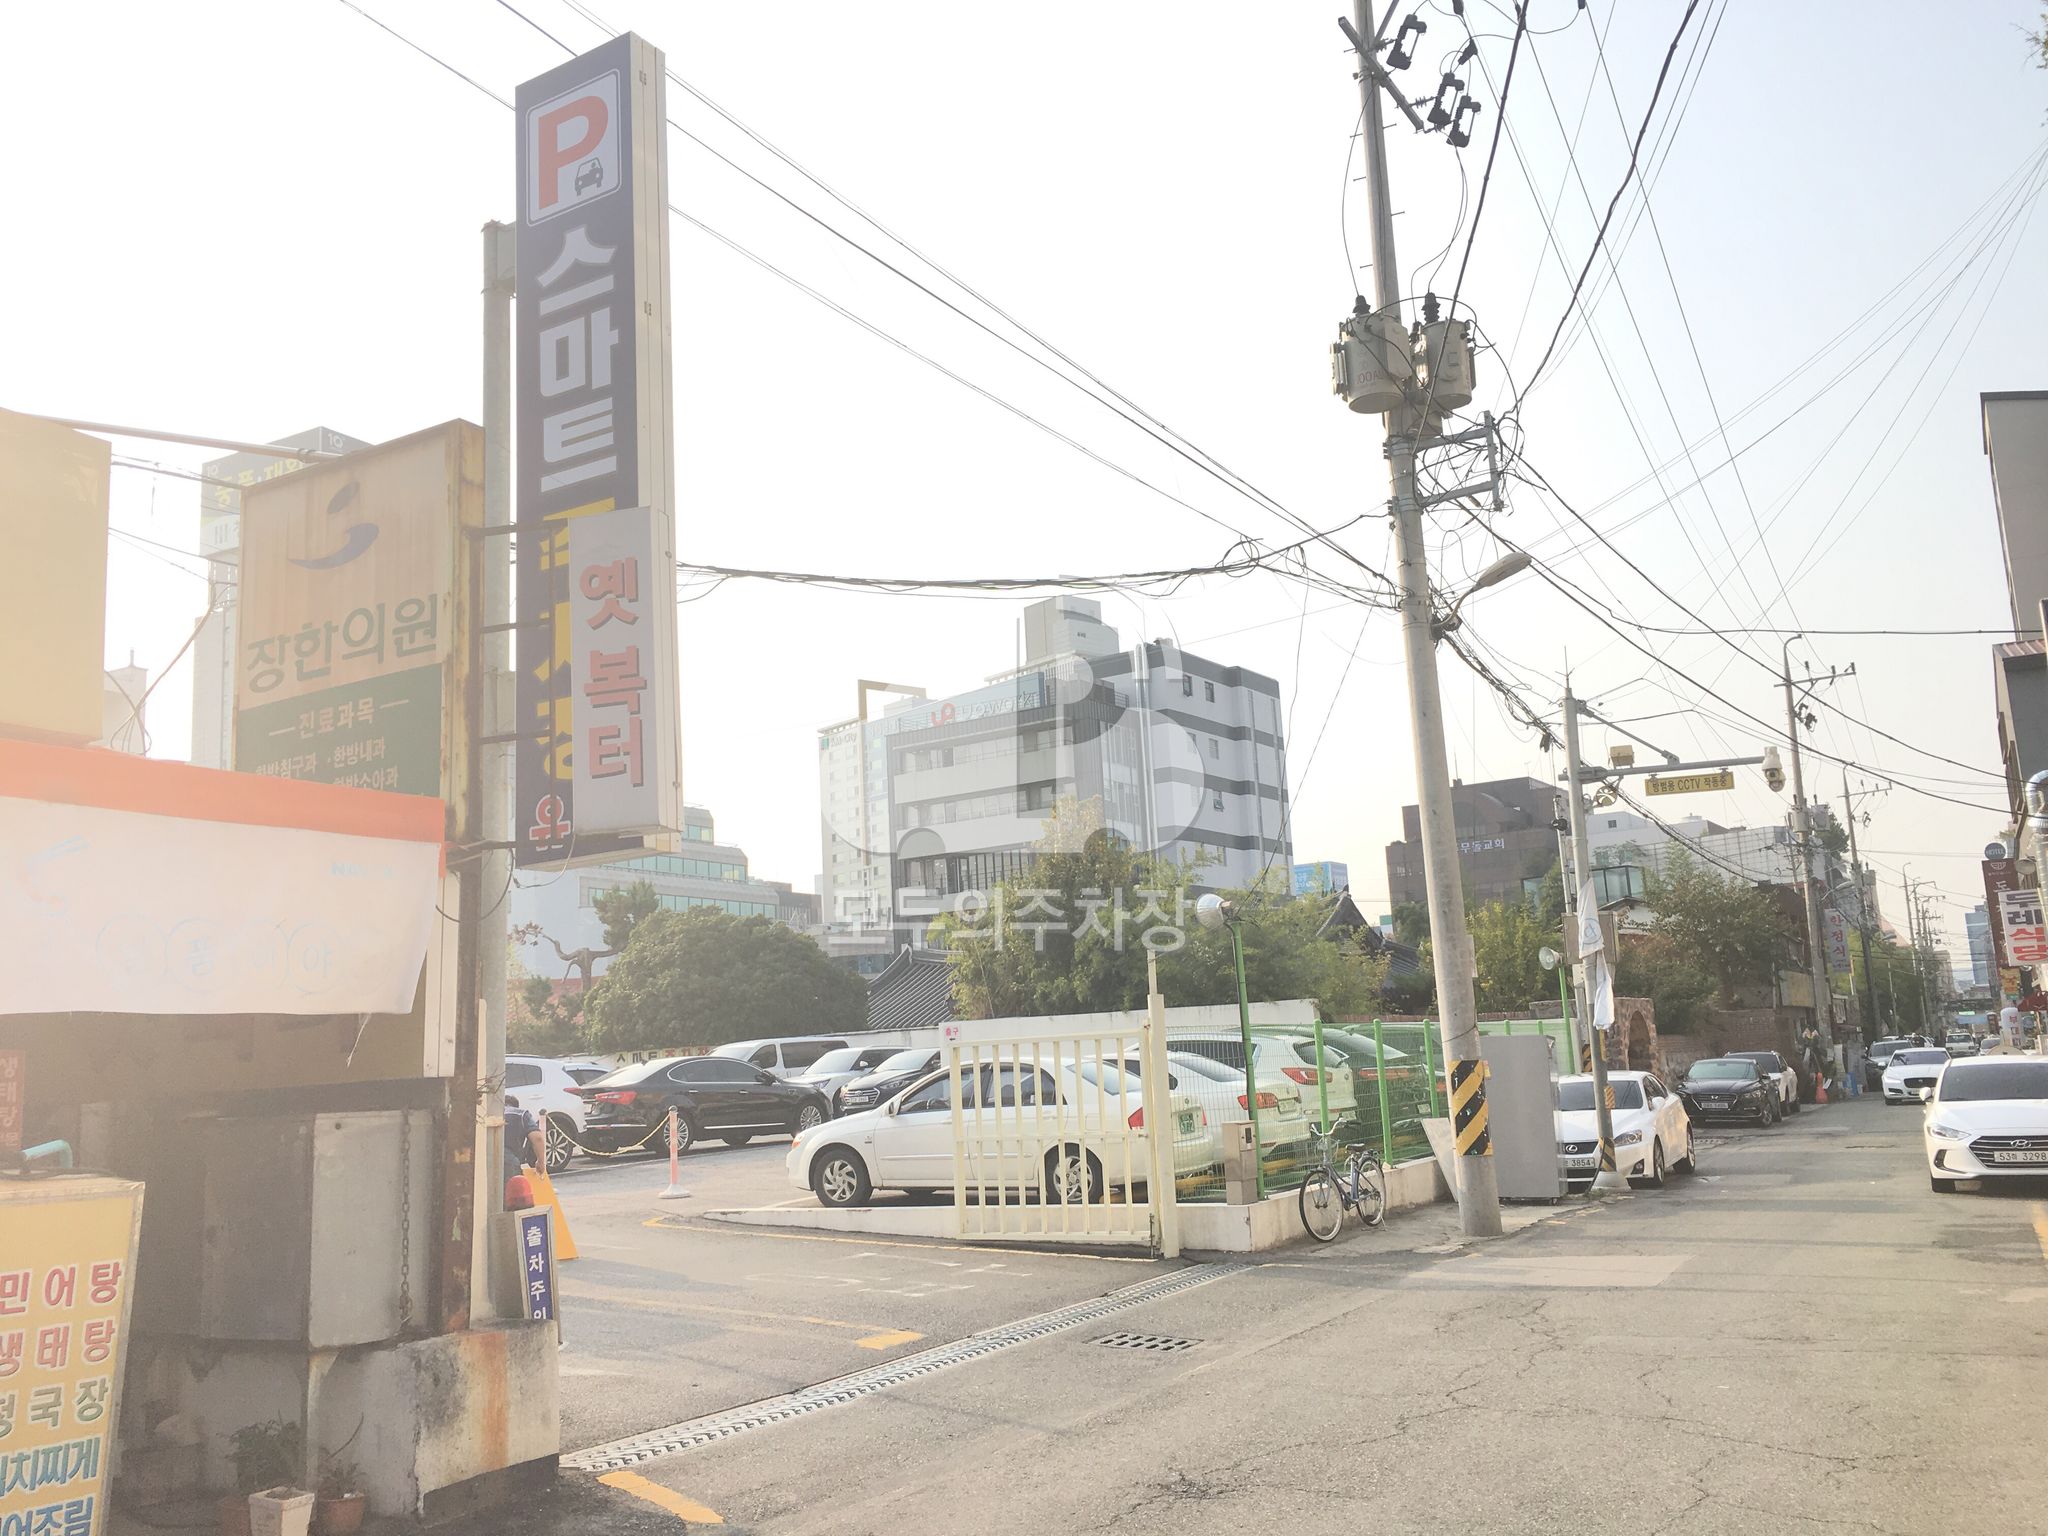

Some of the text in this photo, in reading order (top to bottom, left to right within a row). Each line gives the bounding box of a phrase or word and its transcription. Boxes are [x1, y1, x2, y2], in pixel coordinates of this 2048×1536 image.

[538, 95, 608, 210] P
[537, 226, 619, 493] 스마트
[247, 593, 438, 693] 장한의원
[580, 557, 647, 787] 옛복터
[1678, 777, 1700, 791] CCTV
[2022, 1152, 2047, 1161] 3298
